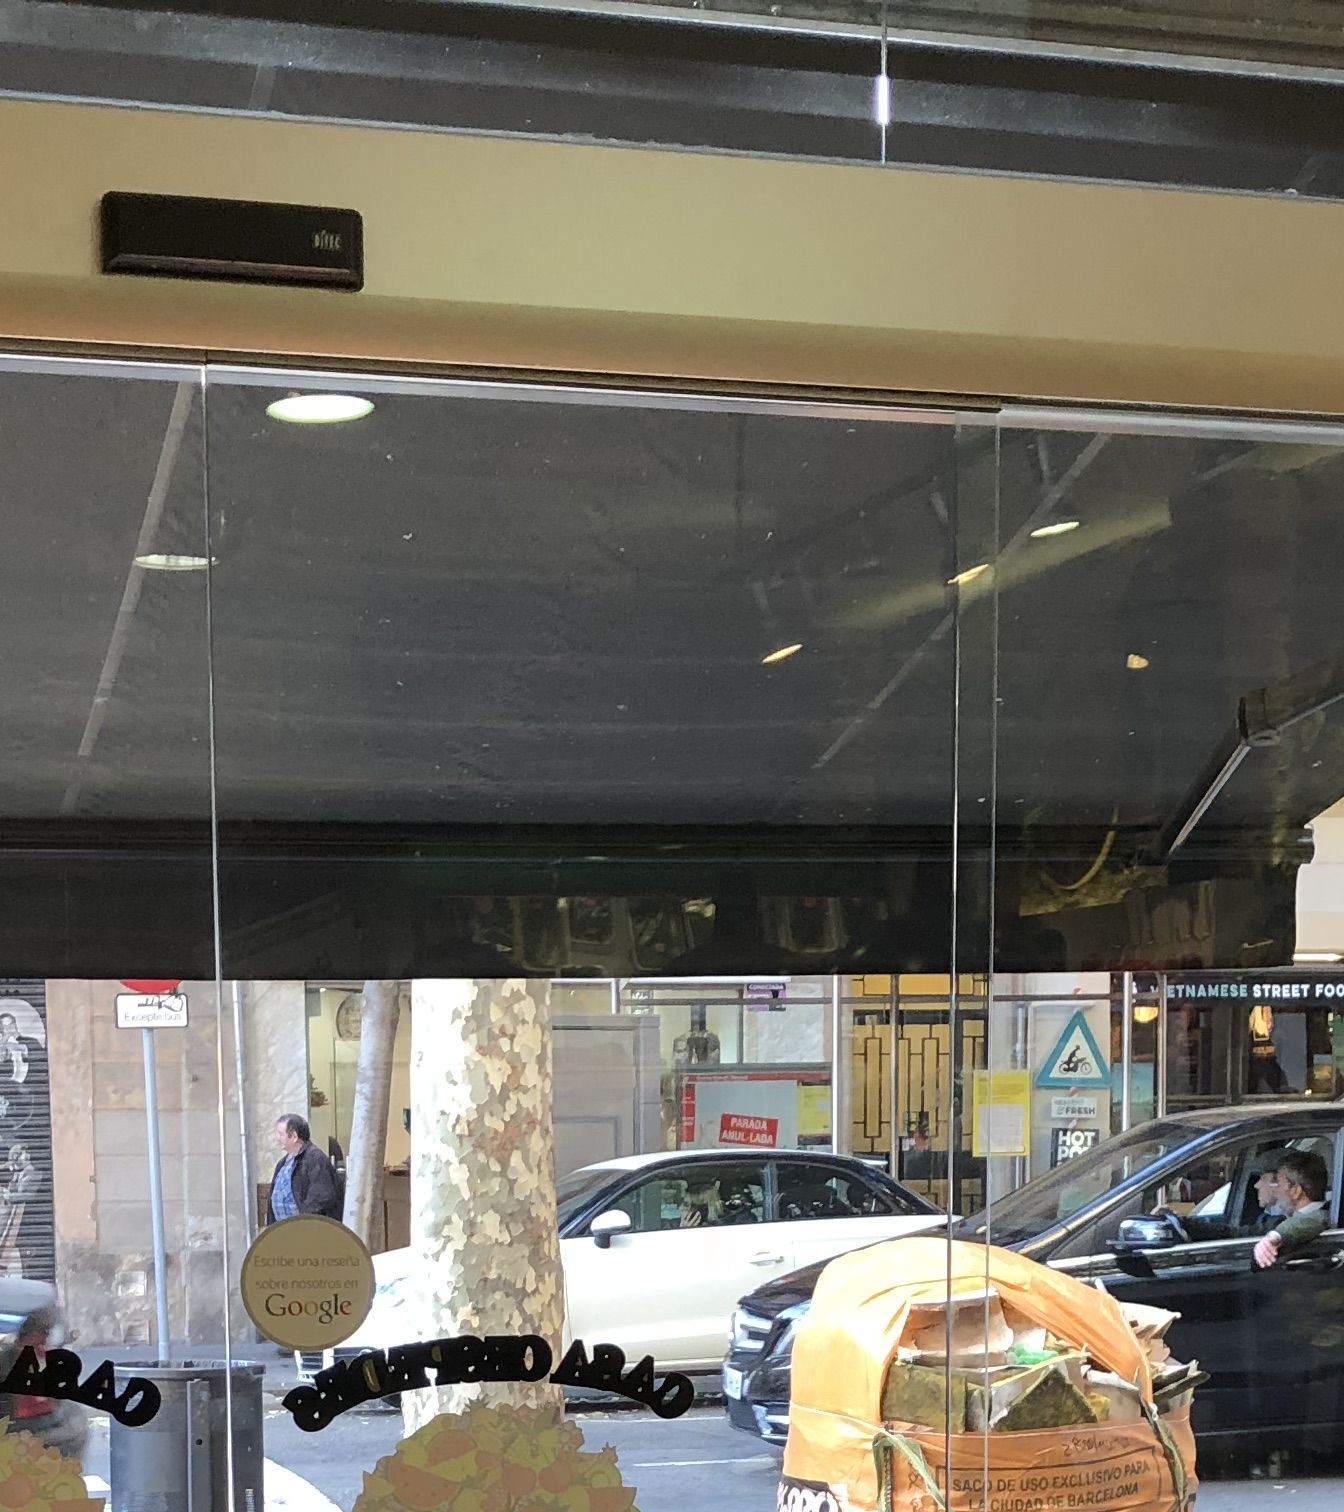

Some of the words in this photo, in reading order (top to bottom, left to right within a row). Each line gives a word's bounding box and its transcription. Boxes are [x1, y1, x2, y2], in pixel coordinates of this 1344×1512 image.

[1150, 984, 1248, 998] ETNAMESE
[1253, 985, 1308, 998] STREET
[1065, 1107, 1096, 1115] FRESH
[730, 1117, 768, 1130] PARADA
[1058, 1130, 1096, 1146] HOT
[254, 1256, 295, 1268] Escribe
[297, 1258, 319, 1268] una
[256, 1279, 288, 1290] sobre
[291, 1279, 342, 1290] nosotros
[344, 1280, 359, 1289] en
[265, 1293, 352, 1324] Google
[953, 1478, 992, 1492] SACO
[996, 1479, 1016, 1491] DE
[1020, 1477, 1049, 1491] USO
[1052, 1467, 1123, 1489] EXCLUSIVO
[1124, 1459, 1151, 1477] PARA
[990, 1496, 1043, 1512] CIUDAD
[1067, 1482, 1139, 1508] BARCELONA
